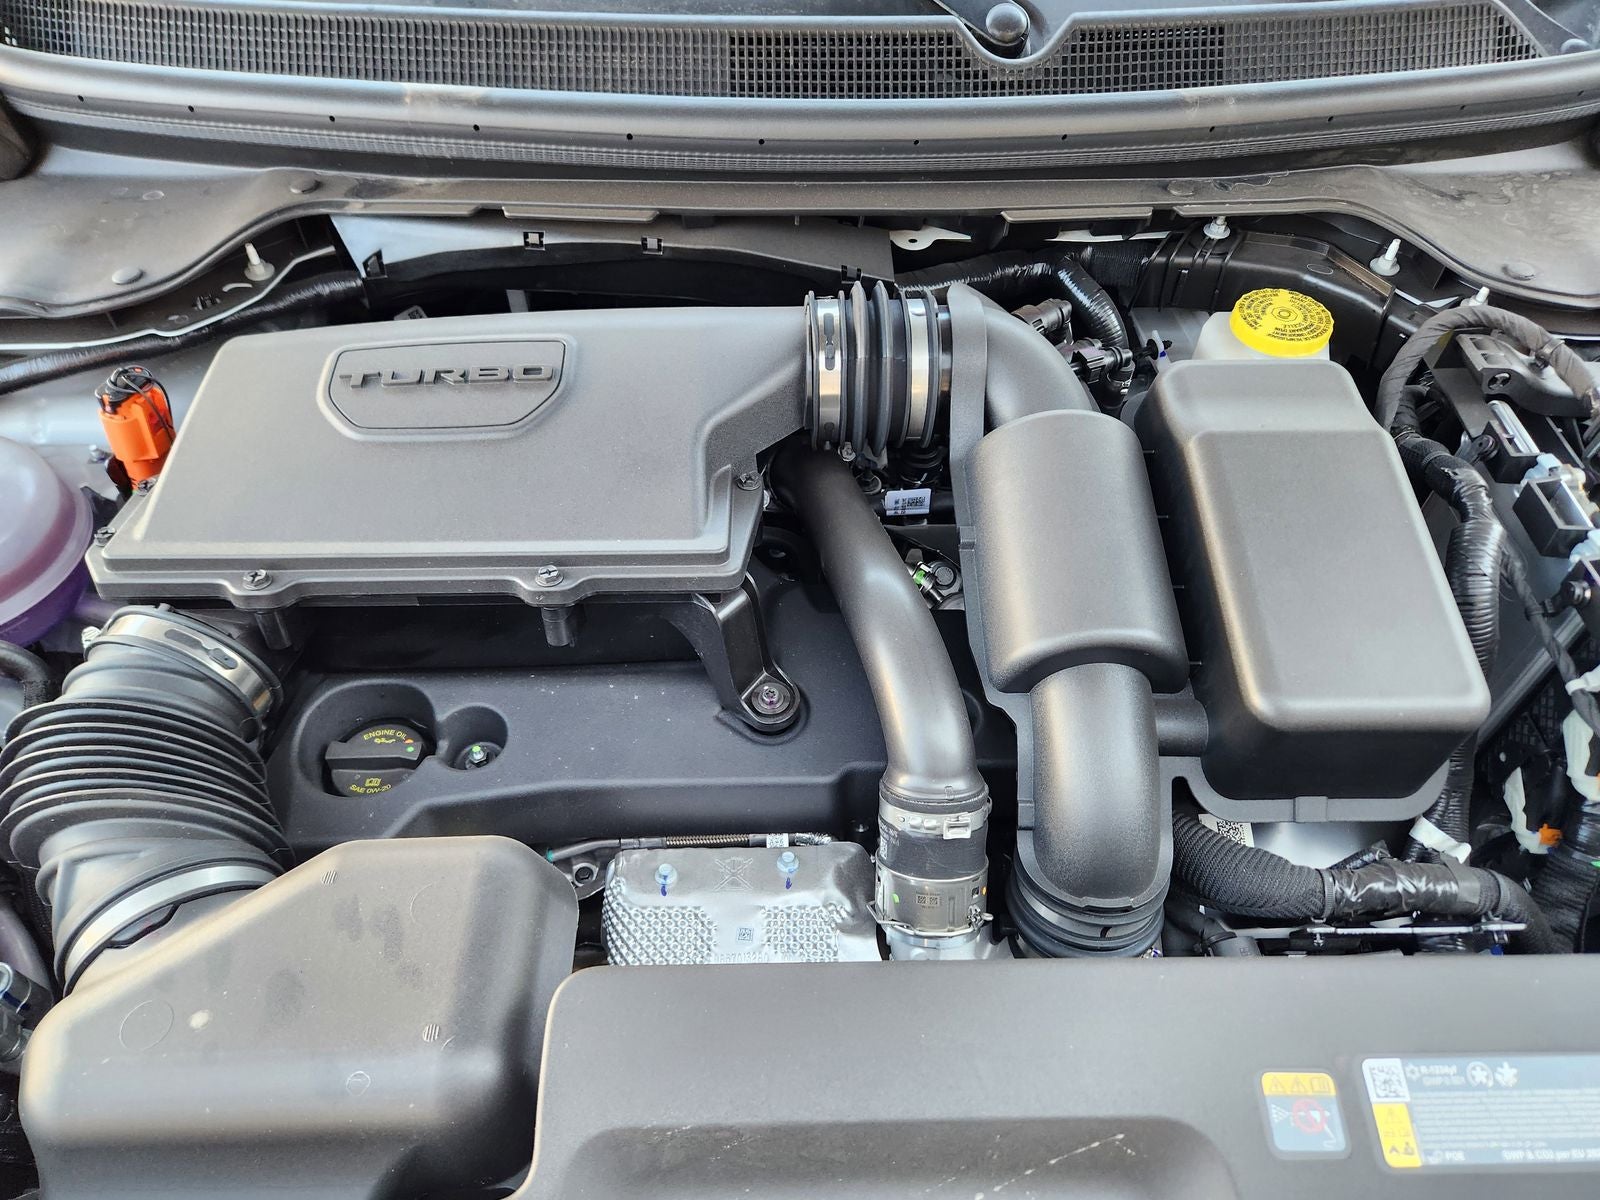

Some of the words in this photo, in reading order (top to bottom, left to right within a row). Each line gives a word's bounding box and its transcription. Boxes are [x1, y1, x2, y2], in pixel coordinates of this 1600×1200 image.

[339, 365, 553, 388] TURBO
[363, 729, 395, 740] ENGINE
[396, 731, 408, 740] OIL
[350, 784, 365, 793] SAE
[366, 783, 392, 793] 0W-20
